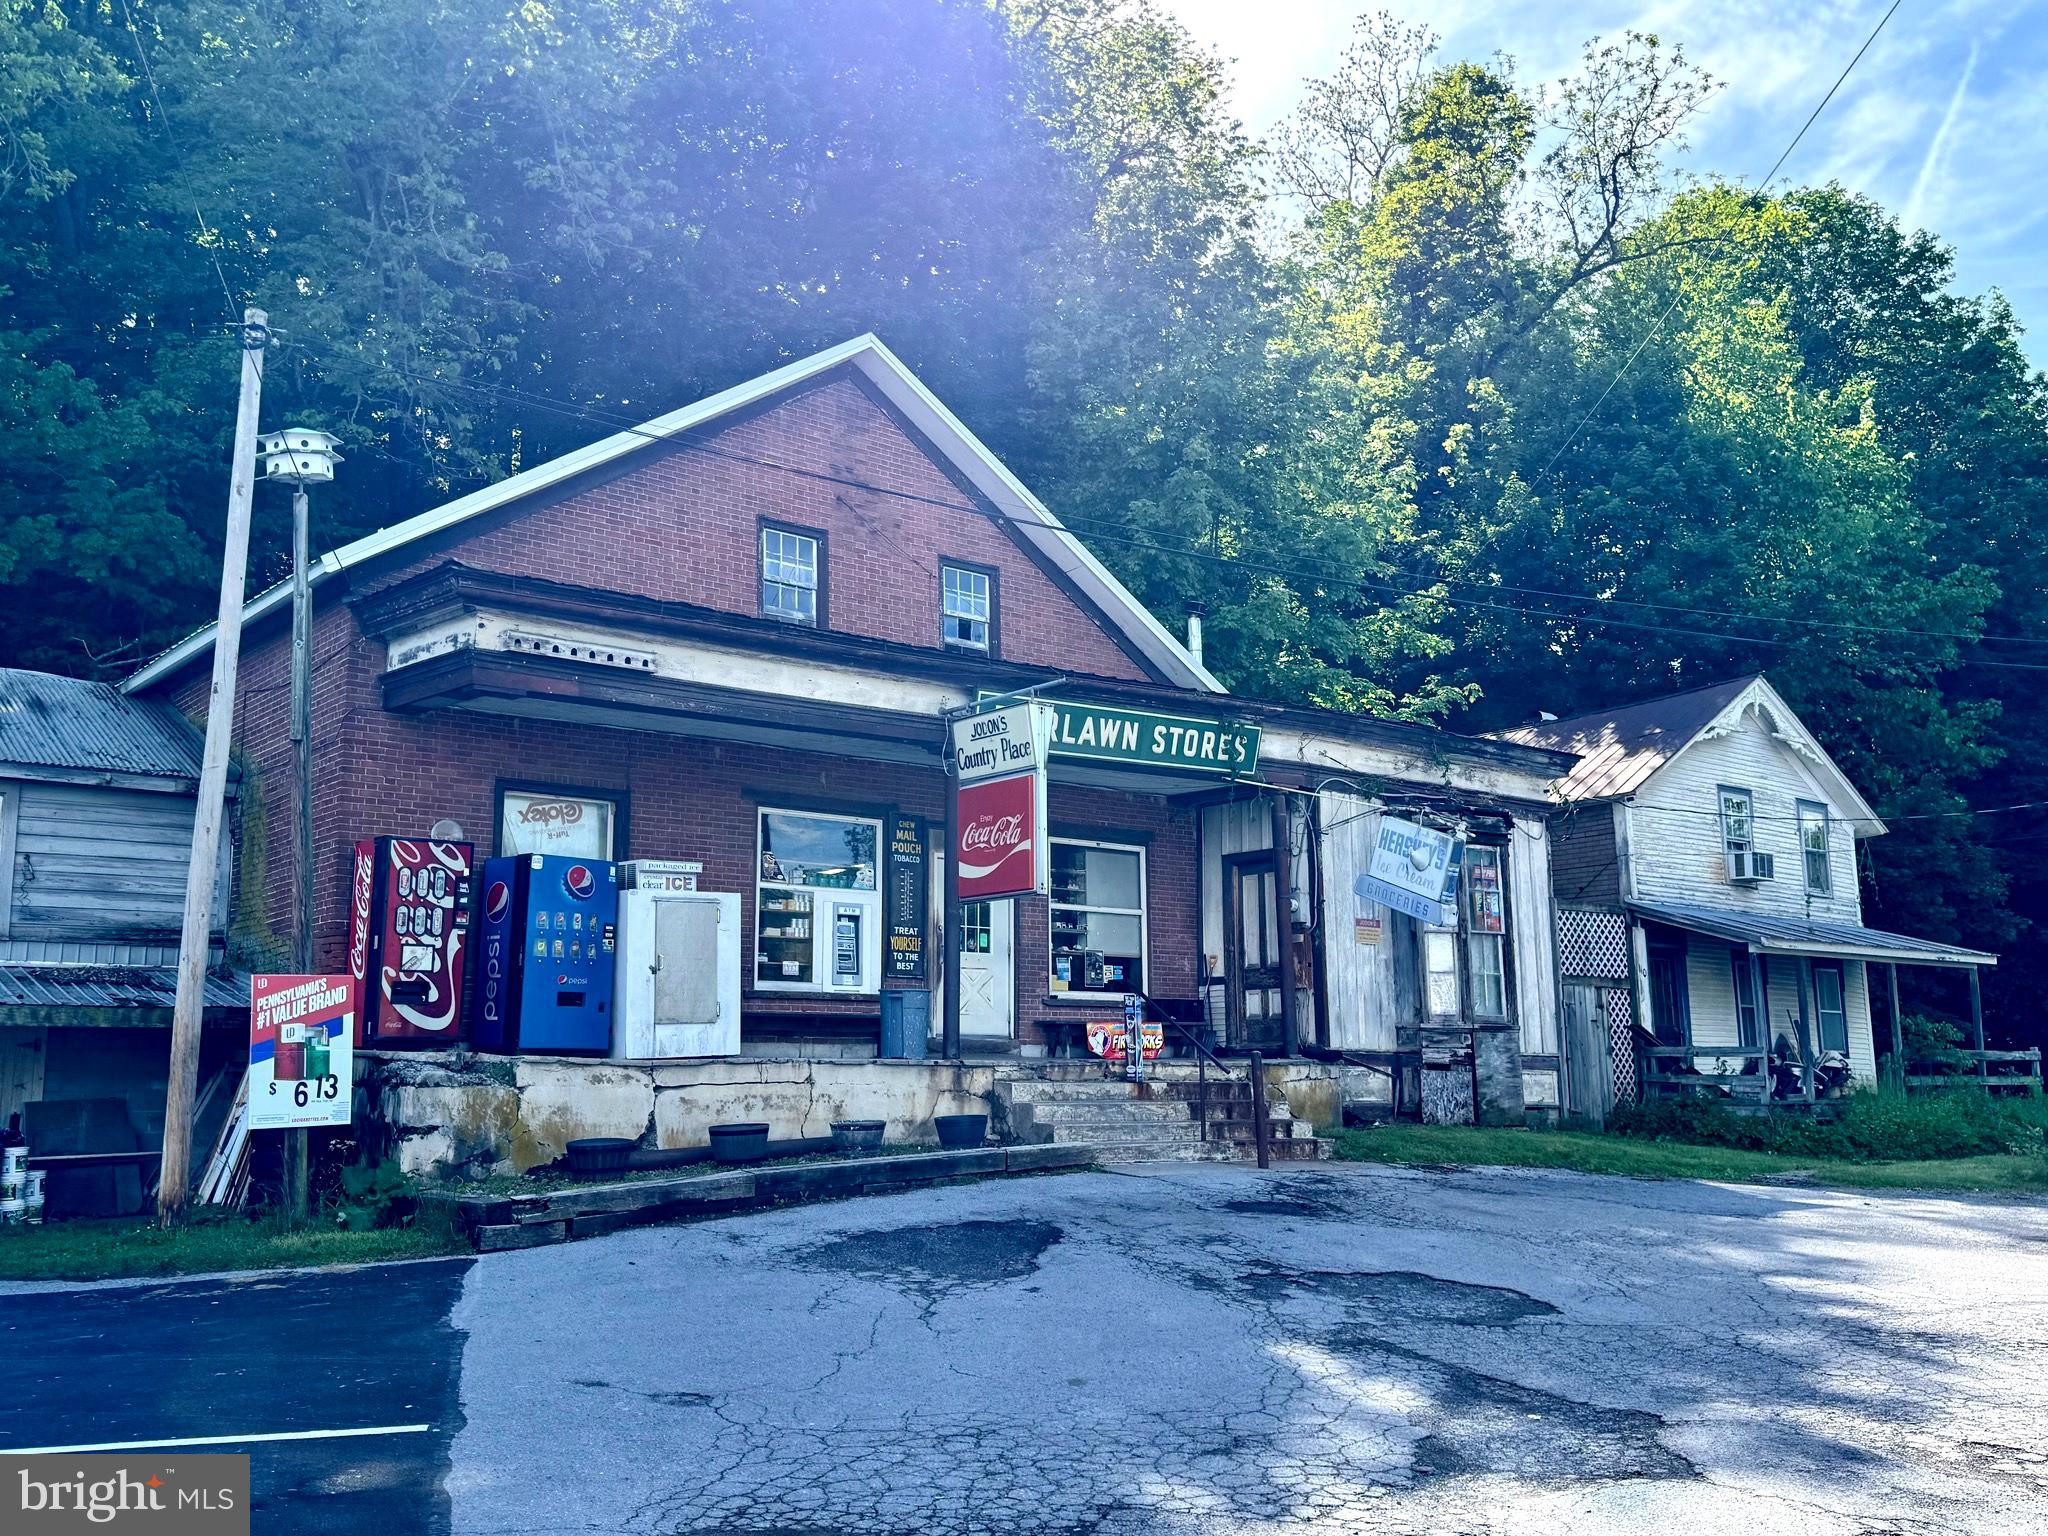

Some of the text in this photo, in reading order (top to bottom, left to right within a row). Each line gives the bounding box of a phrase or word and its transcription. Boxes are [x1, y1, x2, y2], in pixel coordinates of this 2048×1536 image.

[1151, 725, 1249, 763] STORES
[957, 737, 1032, 771] Country Place
[898, 820, 915, 829] CHEW
[962, 812, 1024, 851] Coca-Cola
[896, 829, 917, 842] MAIL
[891, 841, 922, 854] POUCH
[893, 854, 920, 864] TOBACCO
[642, 876, 693, 891] clear ICE
[350, 848, 371, 980] Coca-Cola
[893, 926, 919, 936] TREAT
[890, 936, 922, 952] YOURSELF
[893, 952, 919, 961] TO THE
[896, 961, 915, 971] BEST
[257, 978, 268, 989] LD
[484, 934, 502, 1022] pepsi
[256, 977, 327, 1012] PENNSYLVANIA'S
[256, 985, 347, 1031] #1 VALUE BRAND
[294, 1081, 308, 1108] 6
[315, 1073, 338, 1100] 13
